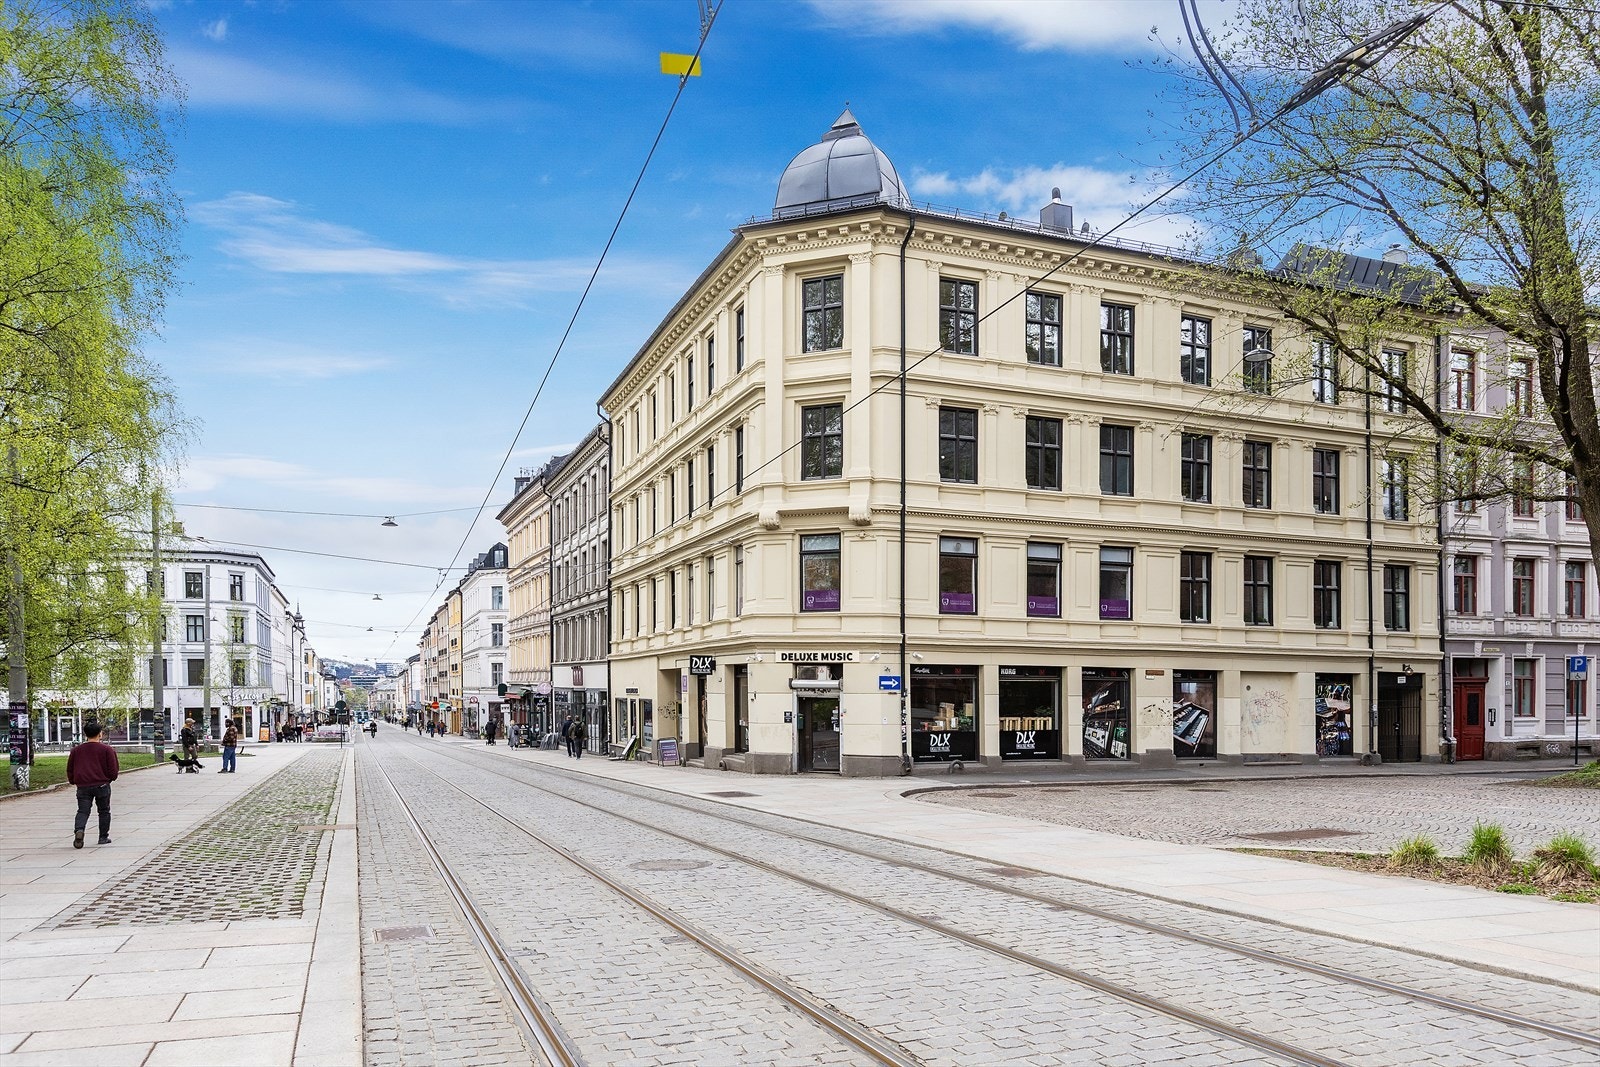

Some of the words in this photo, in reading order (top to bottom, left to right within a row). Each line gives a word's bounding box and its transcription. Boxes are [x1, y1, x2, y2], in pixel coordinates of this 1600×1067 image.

[692, 657, 711, 669] DLX
[781, 653, 818, 661] DELUXE
[821, 653, 853, 661] MUSIC
[1574, 658, 1583, 671] P
[930, 733, 950, 746] DLX
[1016, 731, 1035, 744] DLX
